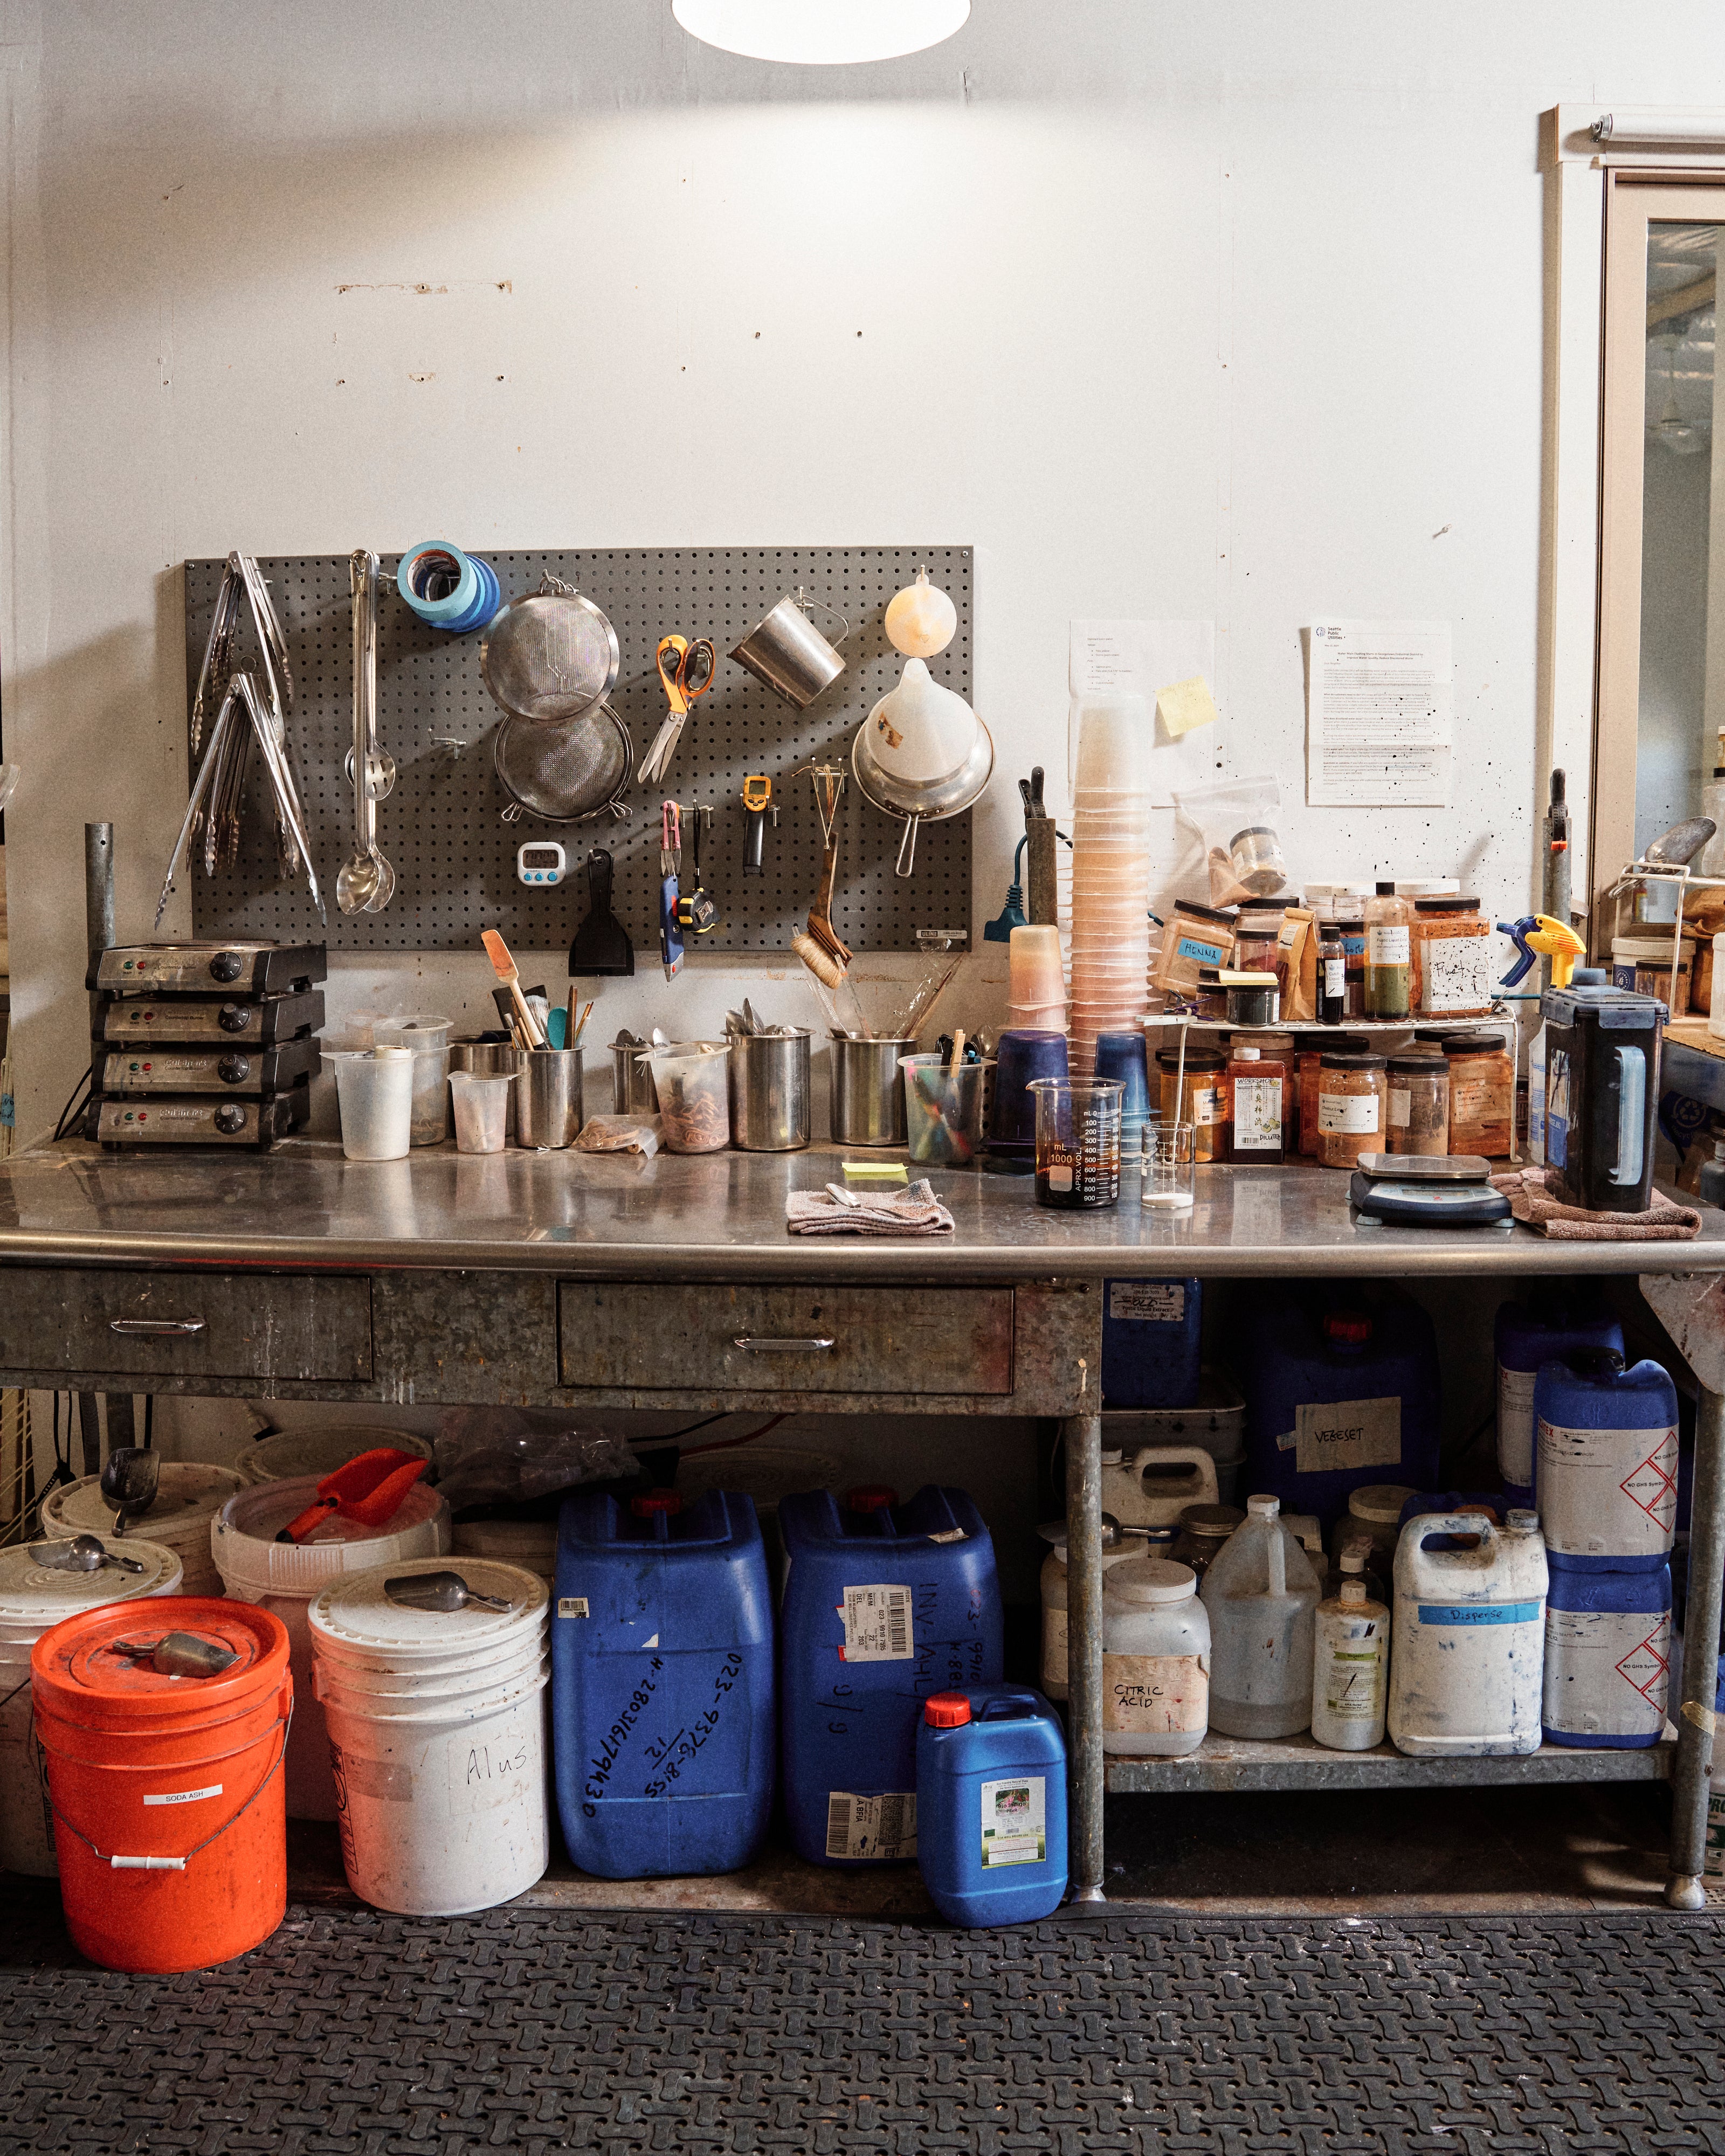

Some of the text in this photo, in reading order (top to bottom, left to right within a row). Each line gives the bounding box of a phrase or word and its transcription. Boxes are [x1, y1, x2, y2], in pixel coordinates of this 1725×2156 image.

[1185, 943, 1216, 959] HENNA
[1051, 1155, 1072, 1163] 1000
[1450, 1610, 1502, 1622] Disperse
[1114, 1684, 1164, 1695] CITRIC
[1119, 1696, 1153, 1708] ACID
